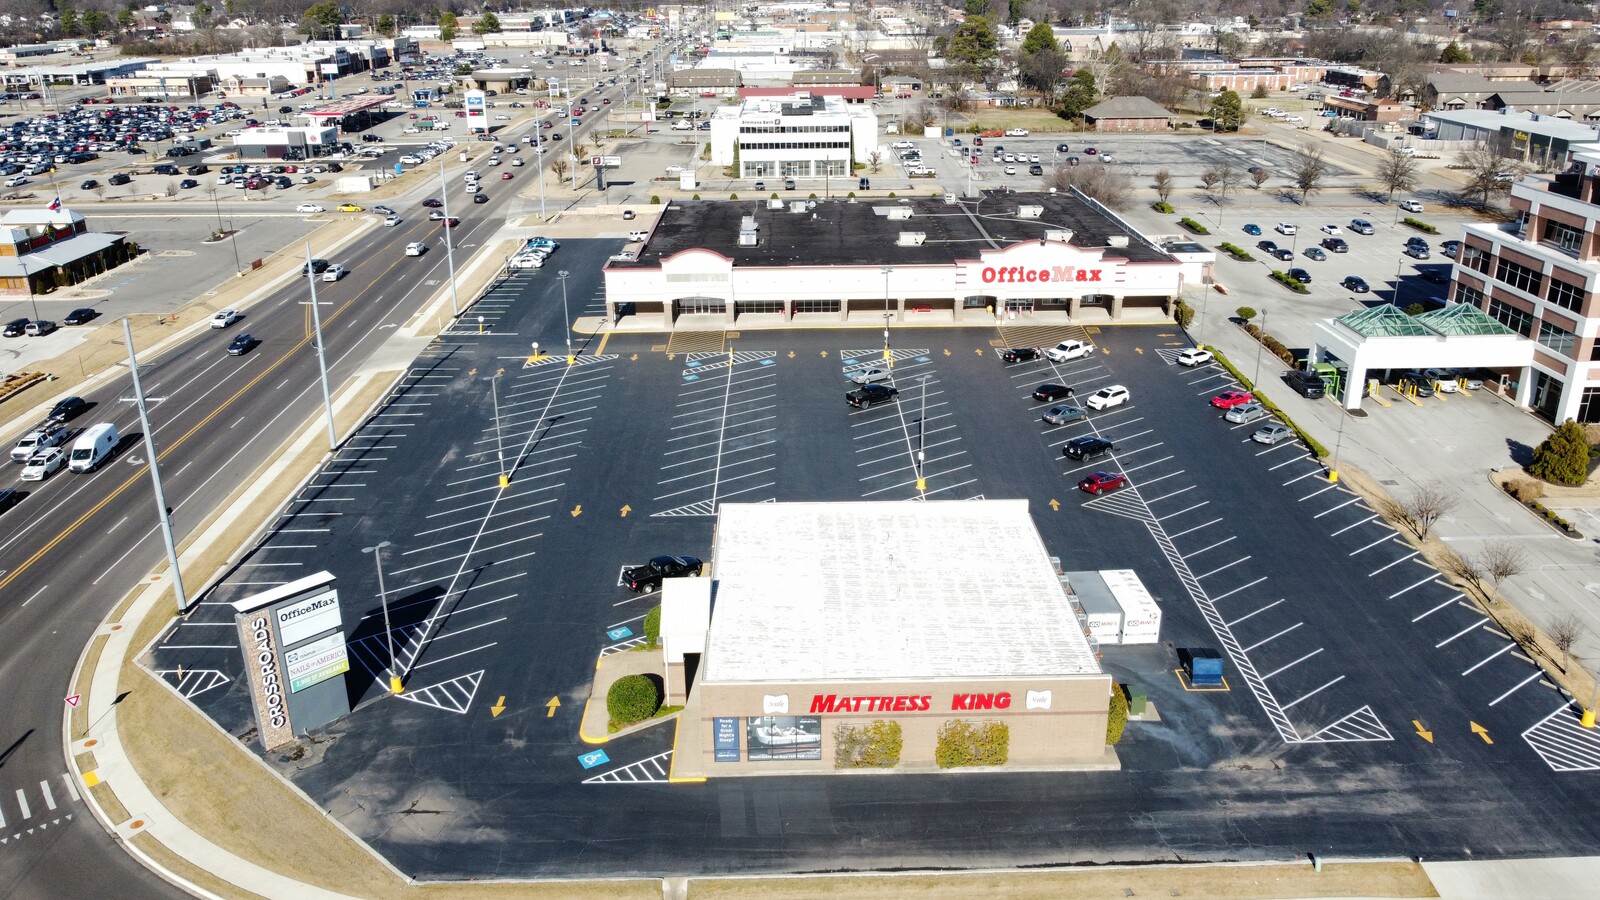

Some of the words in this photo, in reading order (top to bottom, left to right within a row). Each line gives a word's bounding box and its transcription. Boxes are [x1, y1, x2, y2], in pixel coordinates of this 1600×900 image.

[982, 266, 1102, 283] OfficeMax
[280, 597, 336, 622] OfficeMax
[253, 618, 286, 728] CROSSROADS
[290, 662, 310, 675] NAILS
[316, 650, 346, 665] AMERICA
[319, 663, 345, 678] AVAILABLE
[810, 694, 932, 713] MATTRESS
[951, 692, 1012, 710] KING
